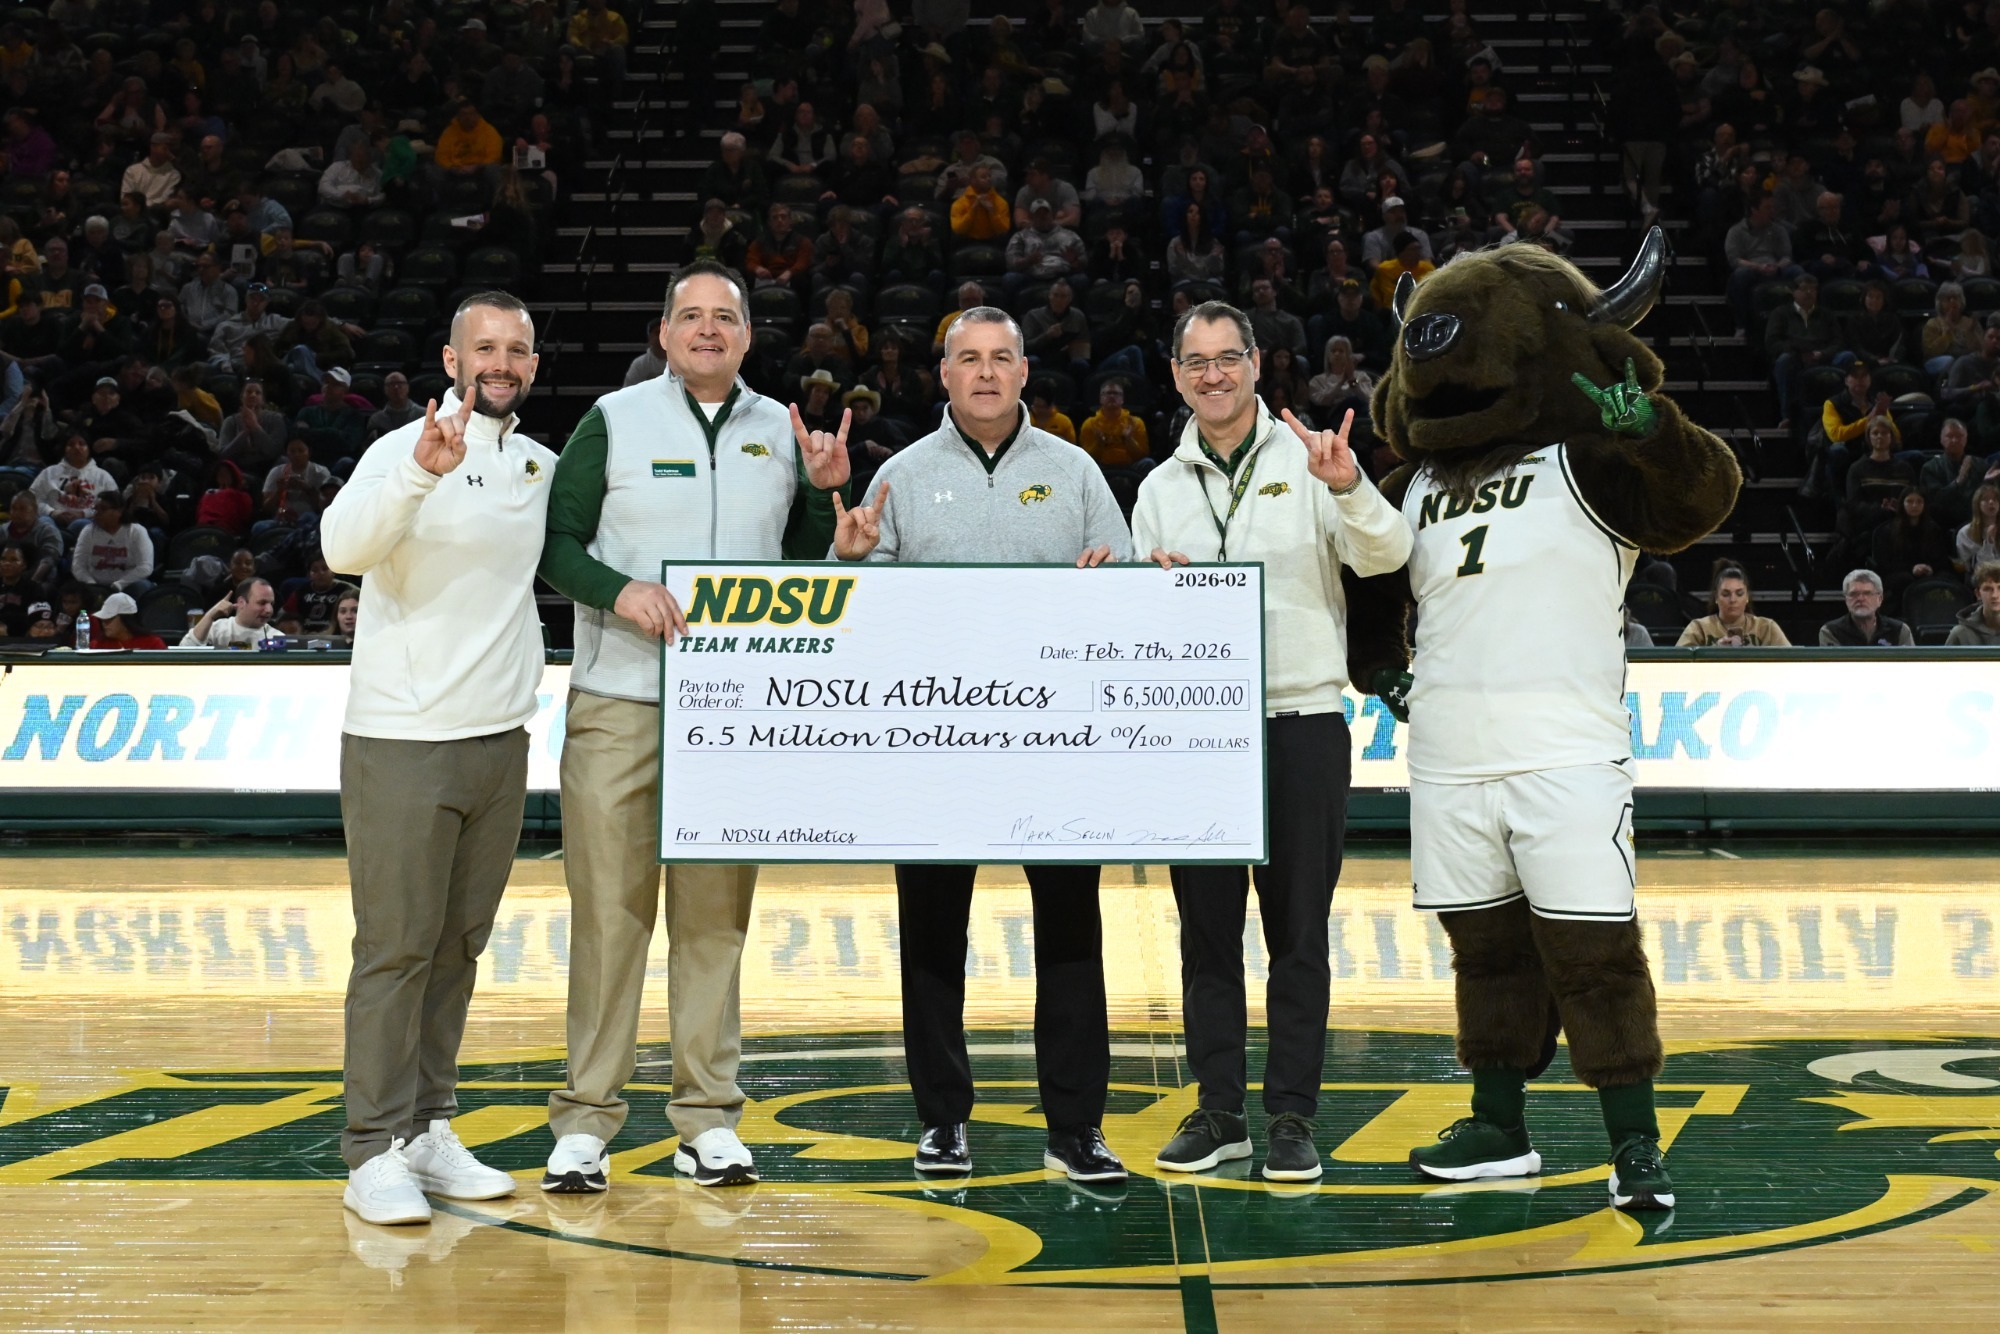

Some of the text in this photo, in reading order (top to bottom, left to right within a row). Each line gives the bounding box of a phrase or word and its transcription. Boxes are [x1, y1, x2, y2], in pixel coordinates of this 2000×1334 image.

[1418, 474, 1535, 531] NDSU
[1456, 524, 1489, 578] 1
[1174, 573, 1247, 588] 2026-02
[684, 576, 856, 626] NDSU
[679, 636, 835, 654] TEAM MAKERS
[1040, 642, 1231, 661] Date: Feb. 7th, 2026
[679, 678, 745, 697] Pay to the
[766, 675, 1057, 709] NDSU Athletics
[1103, 683, 1244, 709] $ 6,500,000.00
[679, 694, 744, 709] Order of:
[687, 725, 736, 747] 6.5
[748, 723, 882, 748] Million
[885, 724, 1018, 749] Dollars
[1022, 724, 1102, 747] and
[1188, 737, 1250, 749] DOLLARS
[676, 827, 858, 844] For NDSU Athletics
